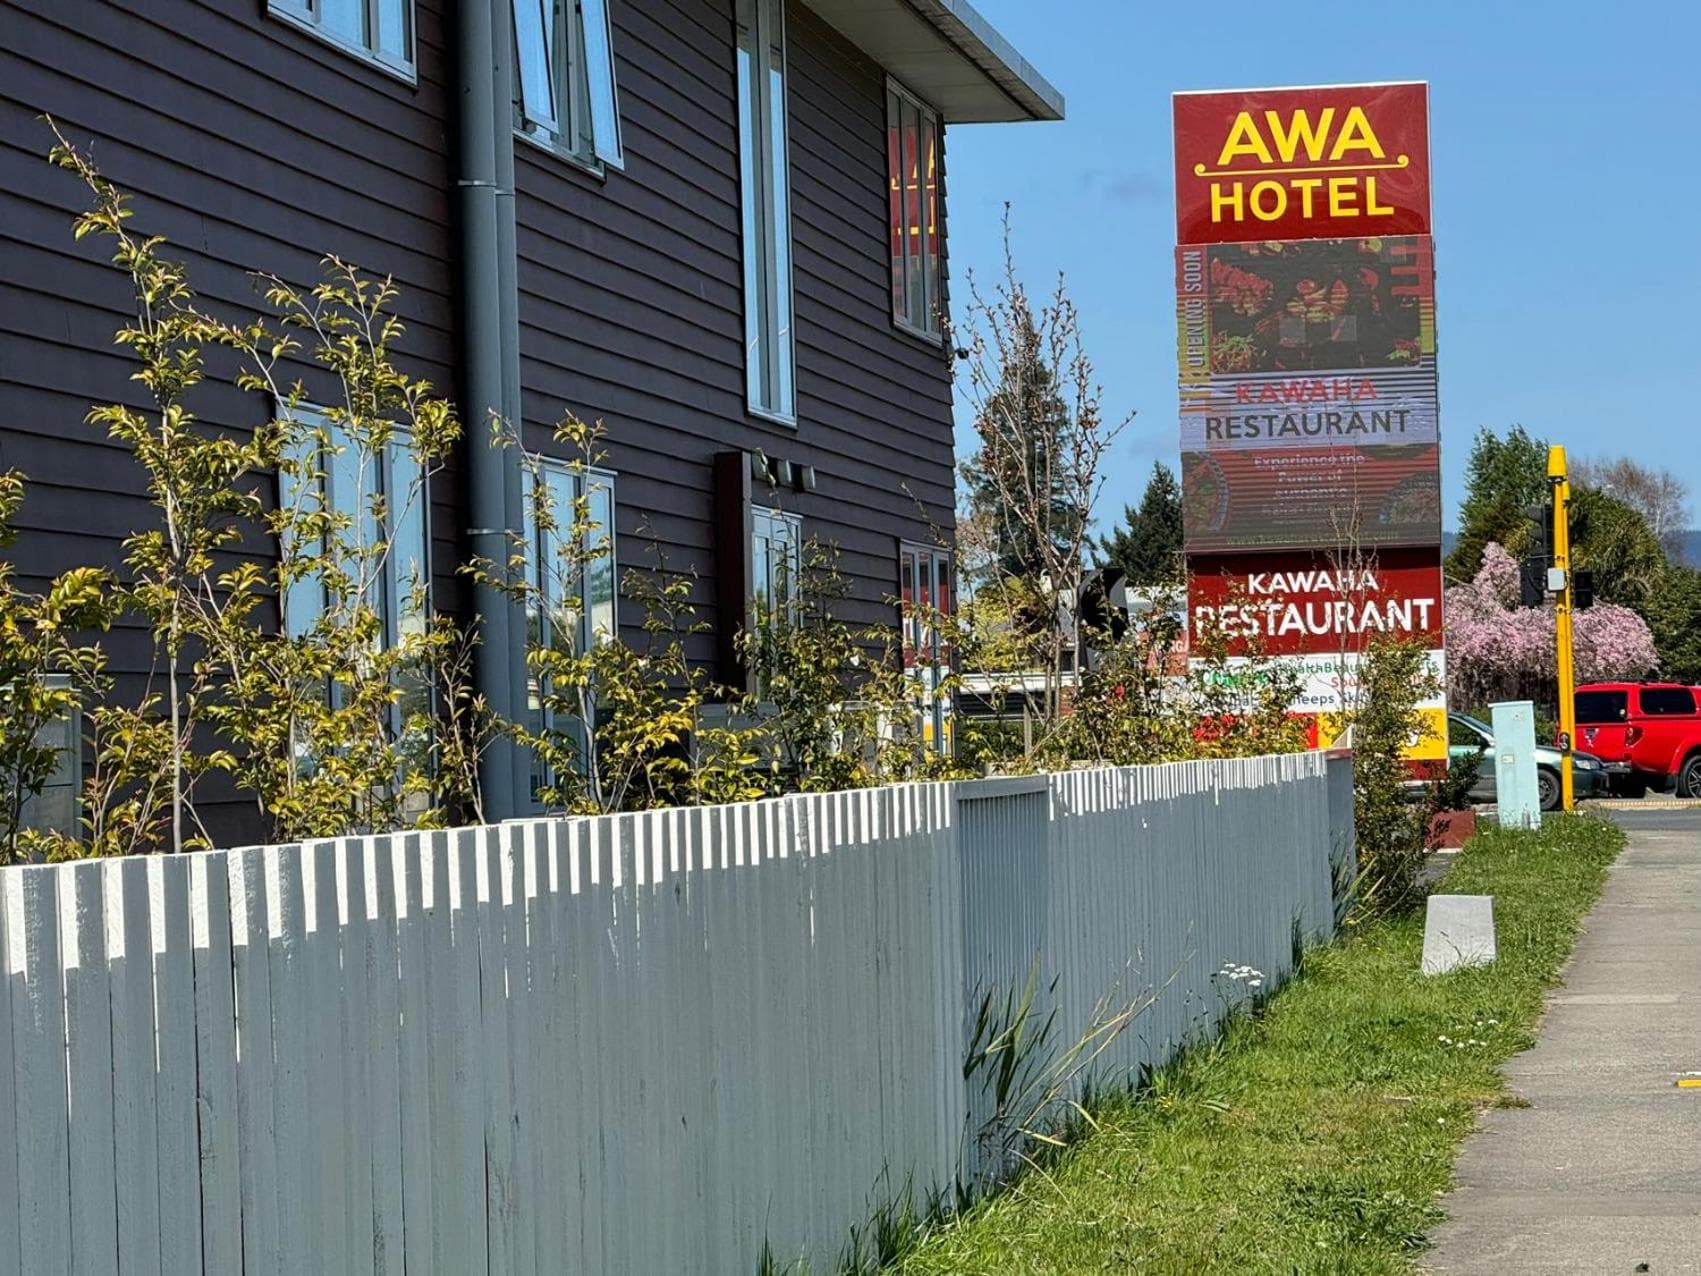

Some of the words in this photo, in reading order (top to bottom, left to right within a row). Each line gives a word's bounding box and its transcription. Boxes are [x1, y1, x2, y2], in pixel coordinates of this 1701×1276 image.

[1217, 106, 1386, 166] AWA
[1210, 176, 1395, 223] HOTEL
[1183, 251, 1201, 293] SOON
[1184, 300, 1203, 367] OPENING
[1235, 378, 1378, 404] KAWAHA
[1205, 409, 1411, 440] RESTAURANT
[1248, 569, 1380, 595] KAWAHA
[1195, 598, 1435, 639] RESTAURANT
